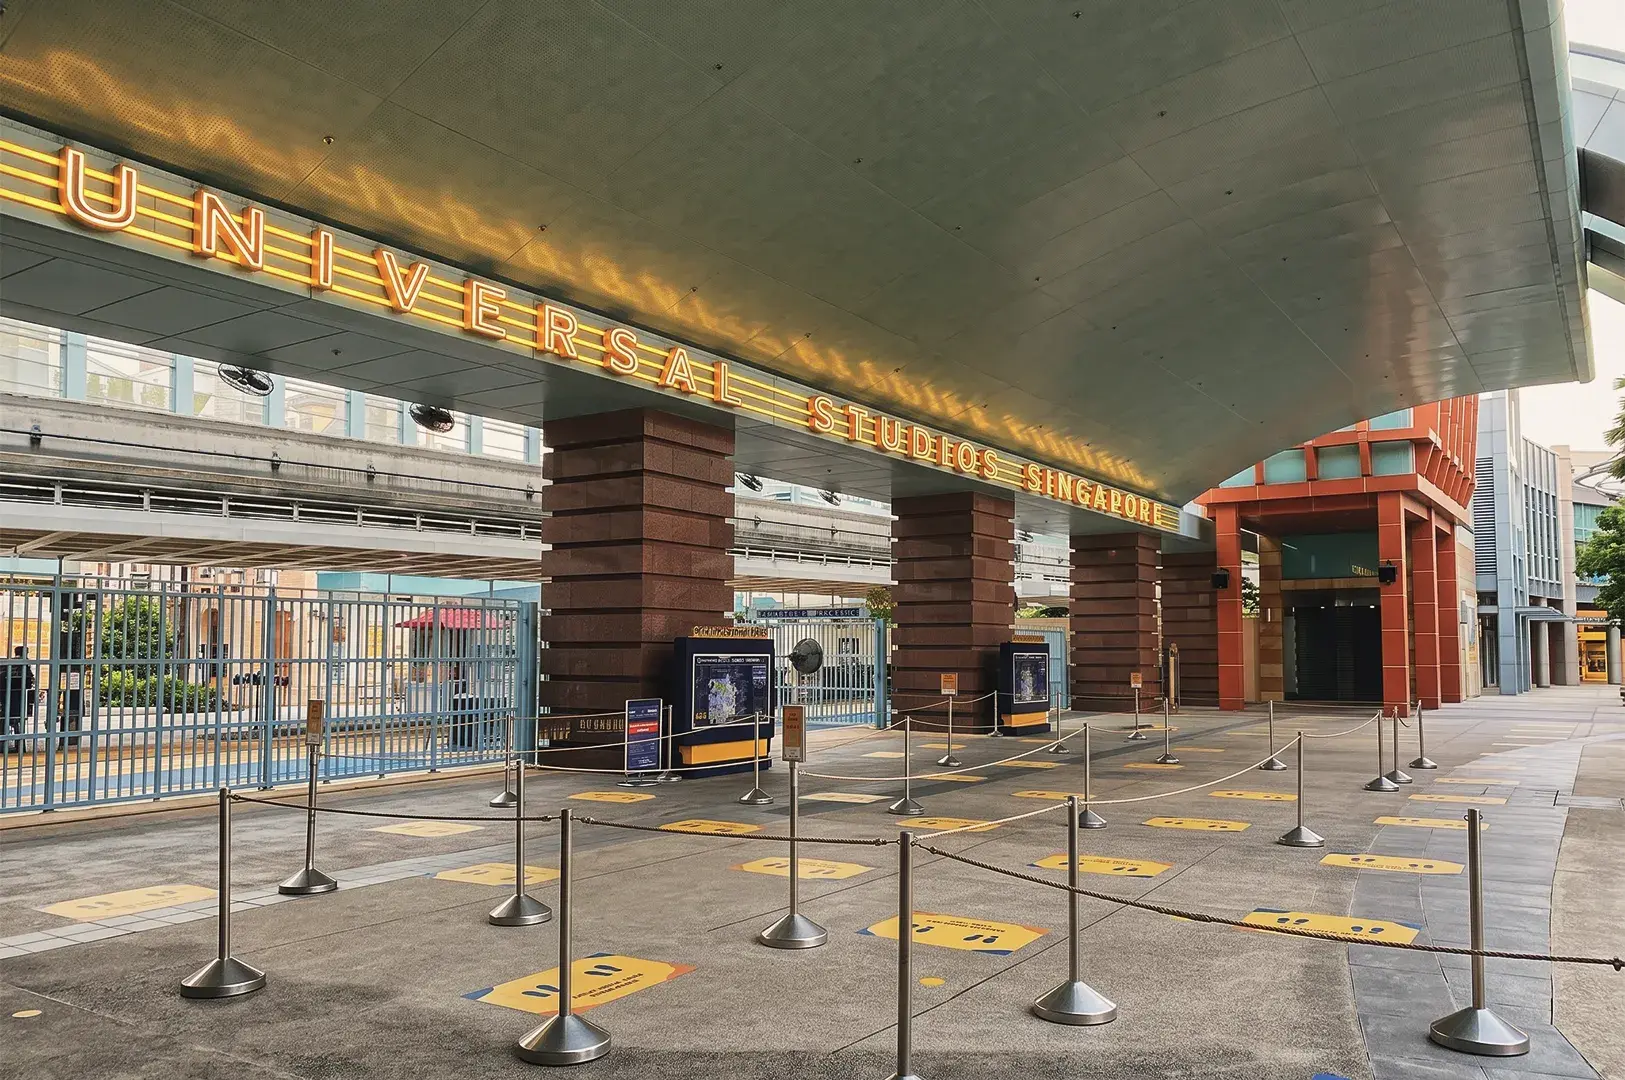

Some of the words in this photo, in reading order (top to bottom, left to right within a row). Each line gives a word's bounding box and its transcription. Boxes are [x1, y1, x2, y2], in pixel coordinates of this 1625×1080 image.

[59, 147, 743, 407] UNIVERSAL
[808, 396, 999, 480] STUDIOS
[1022, 463, 1163, 526] SINGAPORE
